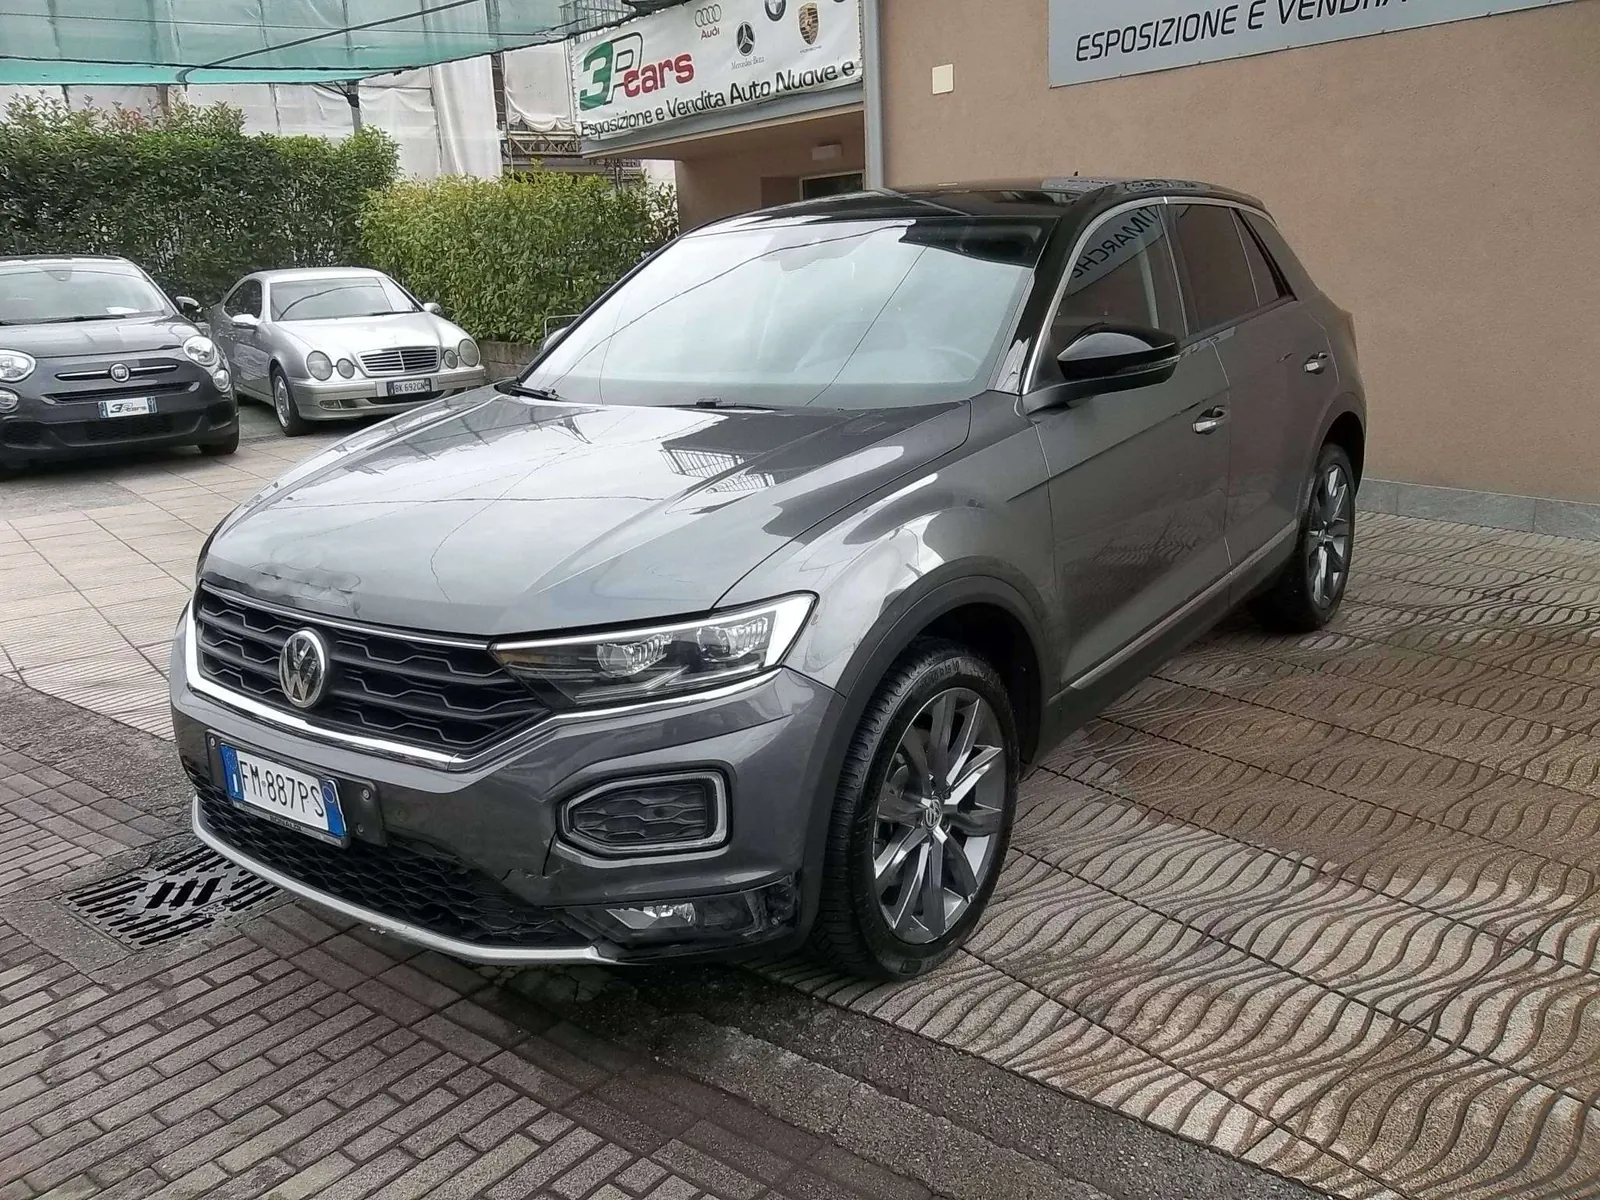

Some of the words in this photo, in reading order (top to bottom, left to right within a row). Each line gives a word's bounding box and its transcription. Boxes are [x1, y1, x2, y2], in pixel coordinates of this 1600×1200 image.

[700, 27, 720, 40] Audi
[1075, 4, 1239, 62] ESPOSIZIONE
[1248, 0, 1267, 30] E
[580, 110, 653, 139] Esposizione
[655, 107, 665, 121] e
[666, 89, 727, 118] Vendita
[729, 80, 771, 105] Auto
[775, 65, 838, 93] Nuove
[842, 60, 855, 76] e
